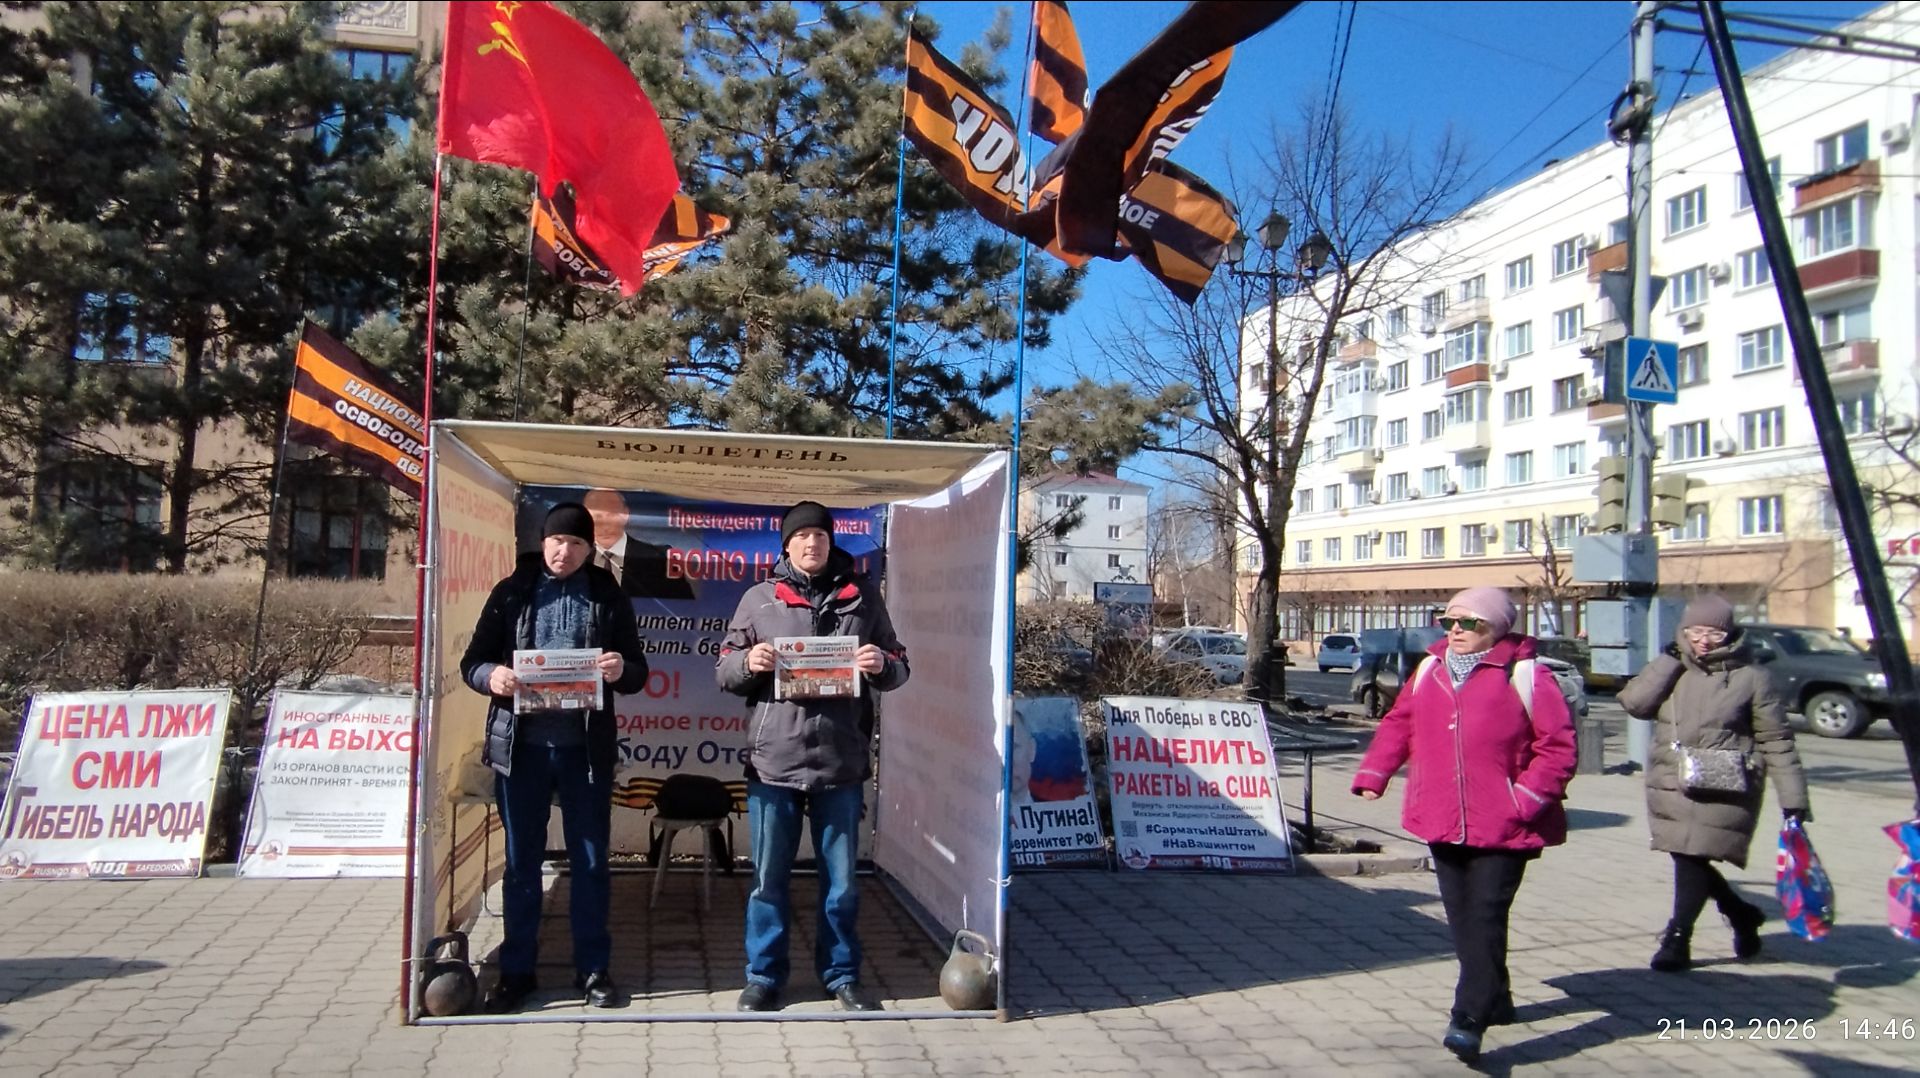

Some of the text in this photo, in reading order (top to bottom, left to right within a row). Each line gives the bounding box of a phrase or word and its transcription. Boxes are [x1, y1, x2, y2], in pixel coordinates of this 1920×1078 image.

[596, 440, 848, 462] БЮЛЛЕТЕНЬ
[668, 508, 766, 532] Президент
[666, 549, 745, 580] ВОЛЮ
[39, 703, 217, 746] ЦЕНА ЛЖИ
[284, 711, 391, 725] ИНОСТРАННЫЕ
[1111, 706, 1141, 726] Для
[1145, 707, 1204, 728] Победы
[1209, 714, 1217, 726] в
[277, 727, 320, 750] НА
[1113, 736, 1266, 768] НАЦЕЛИТЬ
[72, 750, 163, 790] СМИ
[273, 763, 288, 771] ИЗ
[289, 763, 340, 773] ОРГАНОВ
[342, 764, 385, 774] ВЛАСТИ
[271, 776, 308, 785] ЗАКОН
[310, 777, 353, 786] ПРИНЯТ
[362, 779, 396, 787] ВРЕМЯ
[1115, 773, 1272, 798] РАКЕТЫ на США
[108, 801, 205, 842] НАРОДА
[1020, 802, 1095, 834] Путина!
[1075, 832, 1099, 846] РФ!
[1146, 824, 1268, 837] #СарматыНаШтаты
[1162, 839, 1256, 851] #НаВашингтон
[91, 861, 129, 875] НОД
